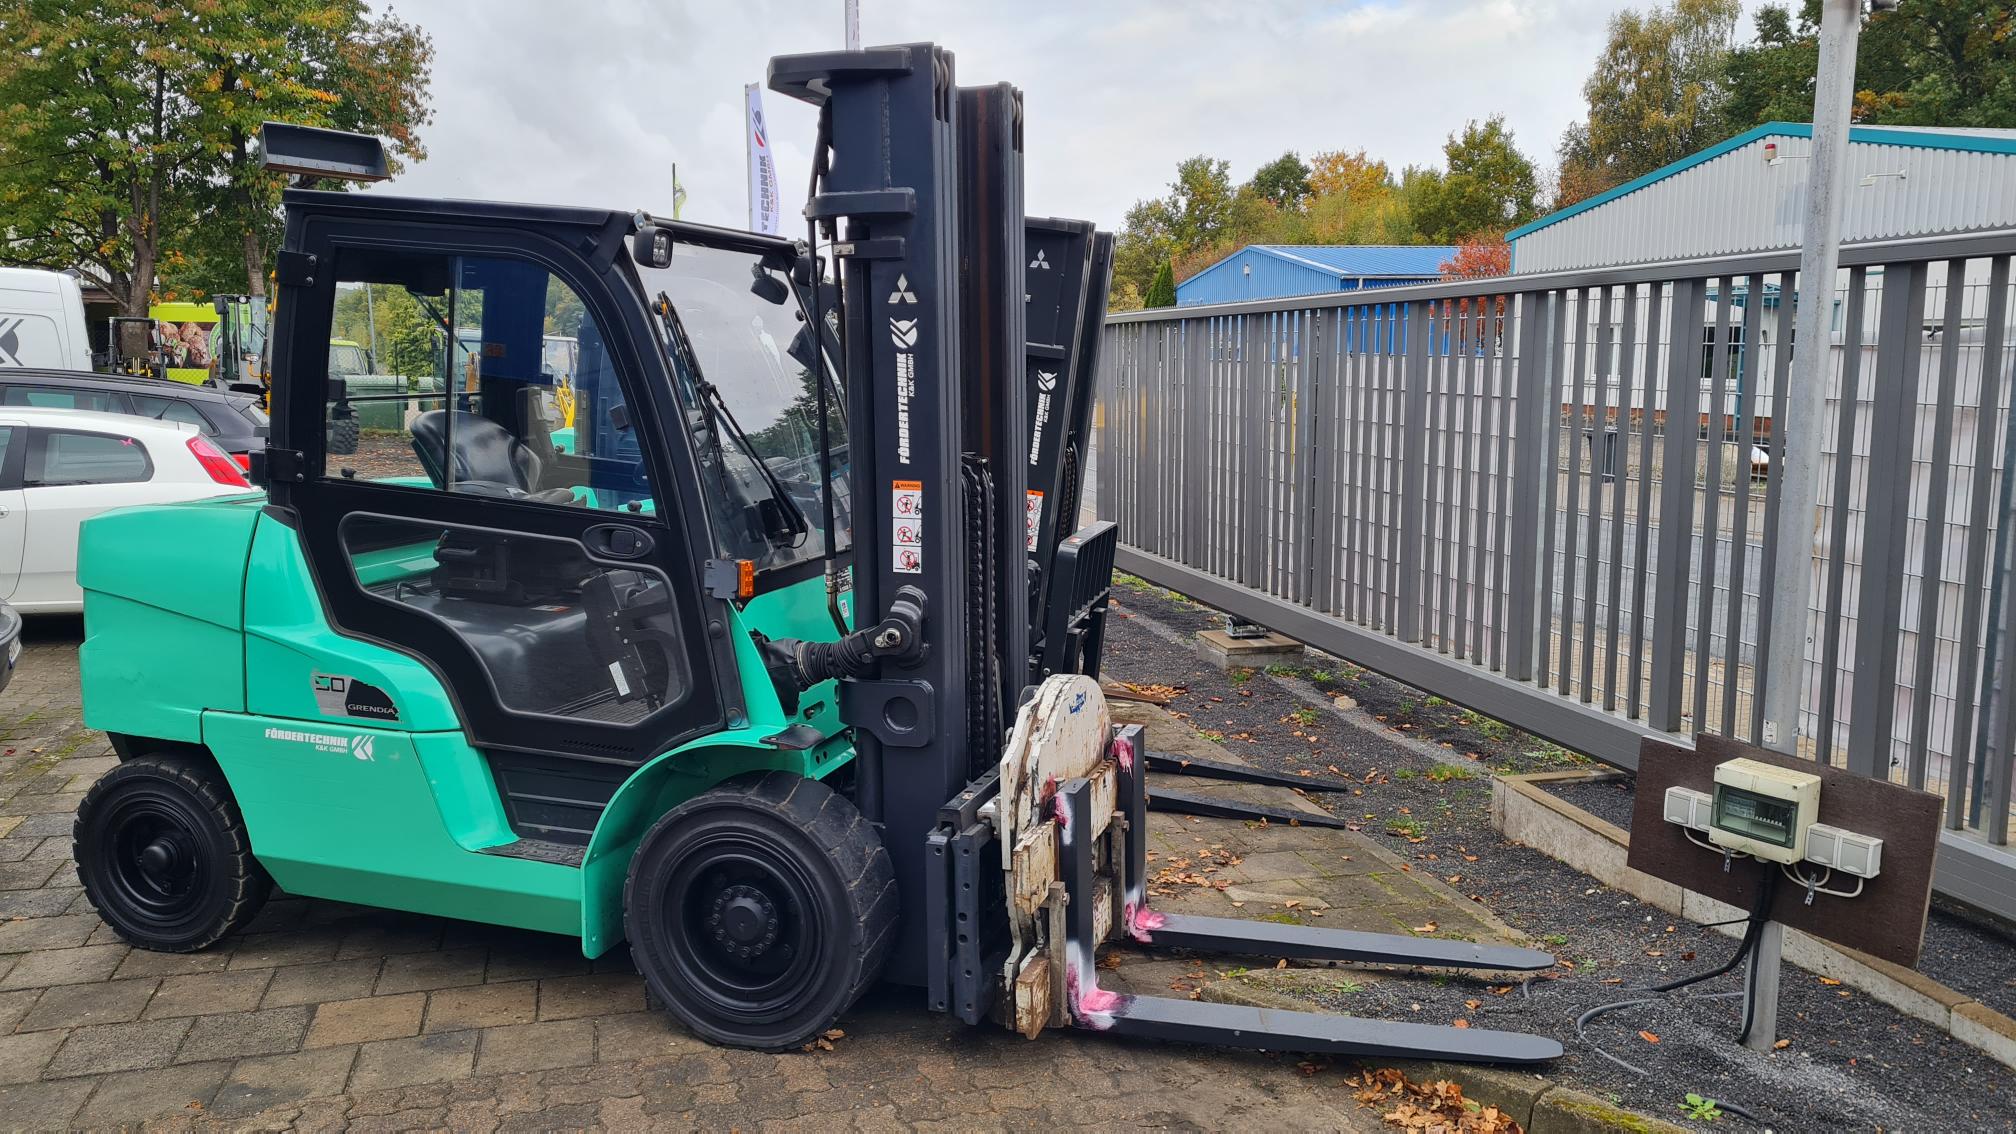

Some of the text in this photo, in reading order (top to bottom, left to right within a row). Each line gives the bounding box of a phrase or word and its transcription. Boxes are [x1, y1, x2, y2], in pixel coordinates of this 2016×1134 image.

[760, 154, 769, 232] TECHNIK
[897, 352, 910, 464] FÖRDERTECHNIK
[1029, 392, 1046, 465] FÖRDERTECHNIK
[347, 703, 396, 715] GRENDIA
[265, 728, 349, 747] FÖRDERTECHNIK
[315, 744, 348, 754] K&K GMBH
